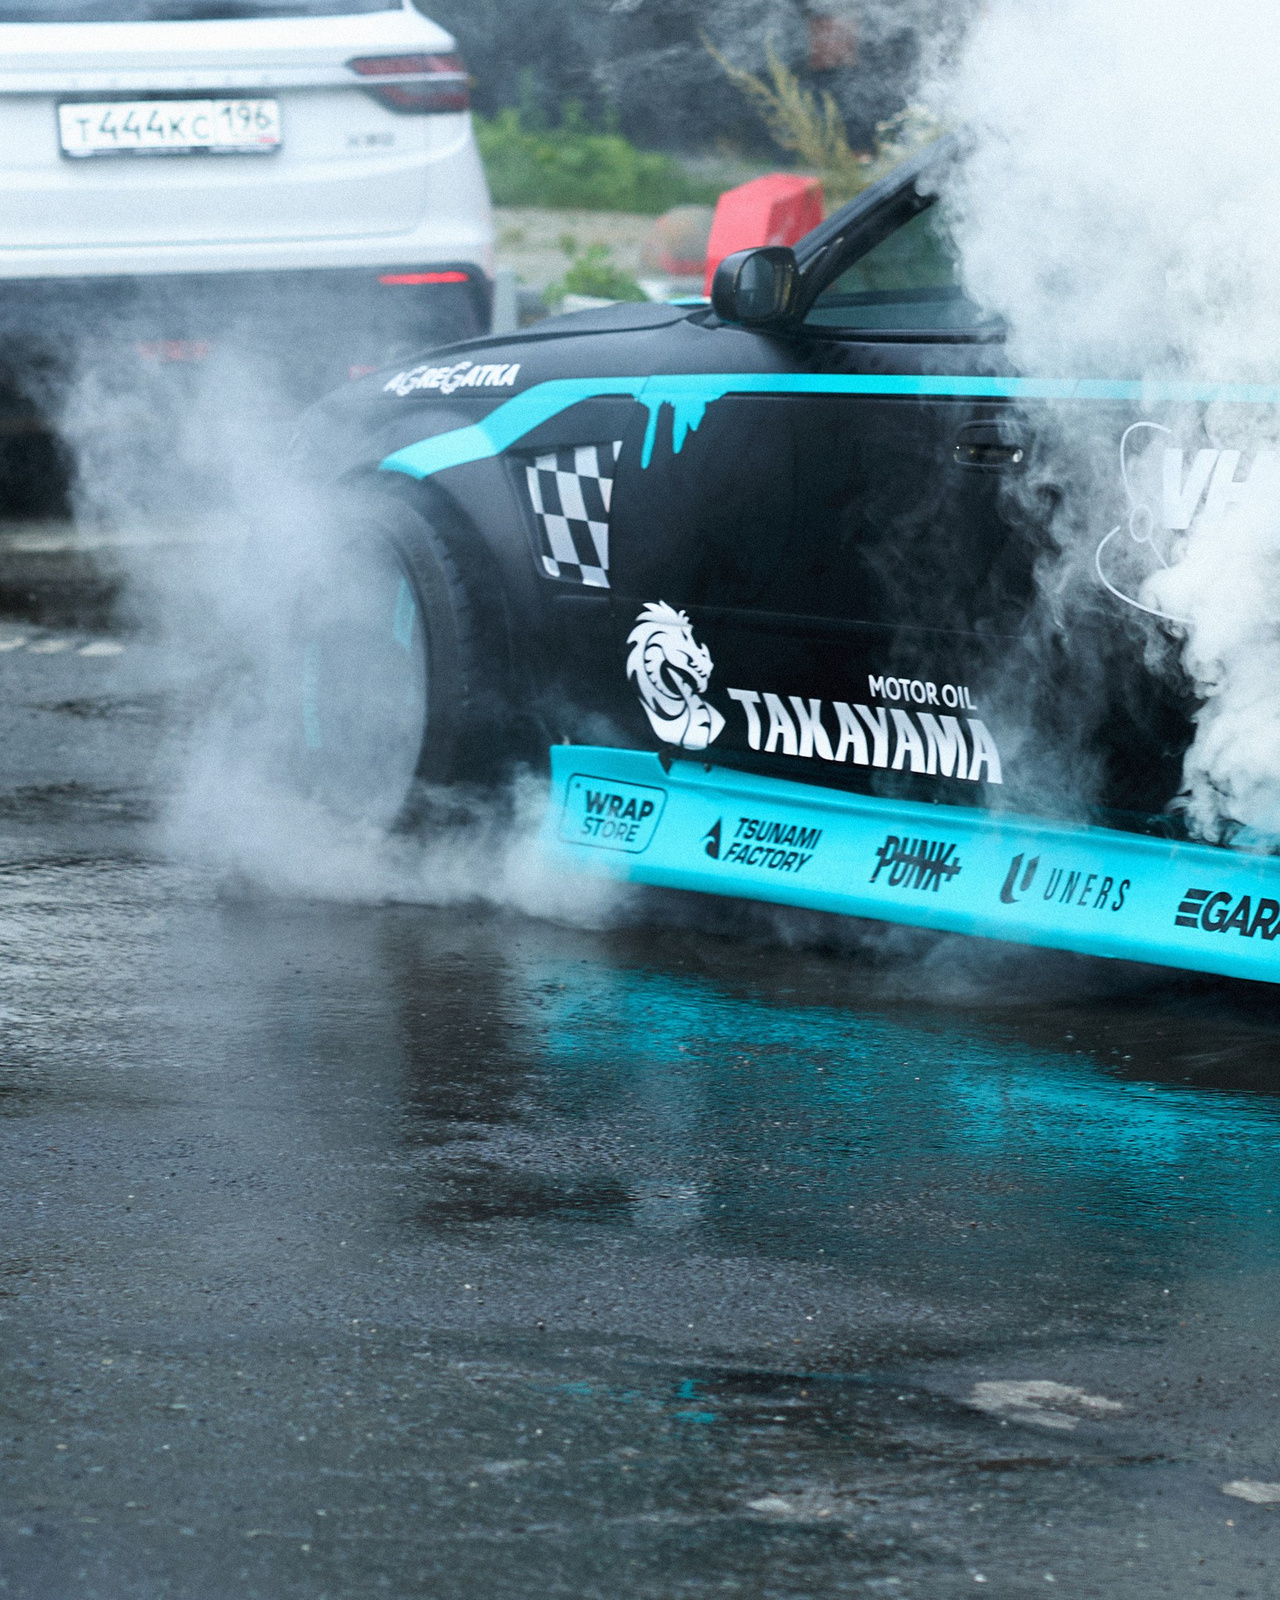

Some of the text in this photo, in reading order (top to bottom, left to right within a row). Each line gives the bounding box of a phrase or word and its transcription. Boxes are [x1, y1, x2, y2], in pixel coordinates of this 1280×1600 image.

[221, 105, 273, 131] 196
[868, 674, 978, 710] MOTOR OIL
[726, 687, 1003, 784] TAKAYAMA
[584, 790, 654, 821] WRAP
[582, 816, 641, 842] STORE
[734, 817, 823, 850] TSUNAMI
[723, 842, 812, 873] FACTORY
